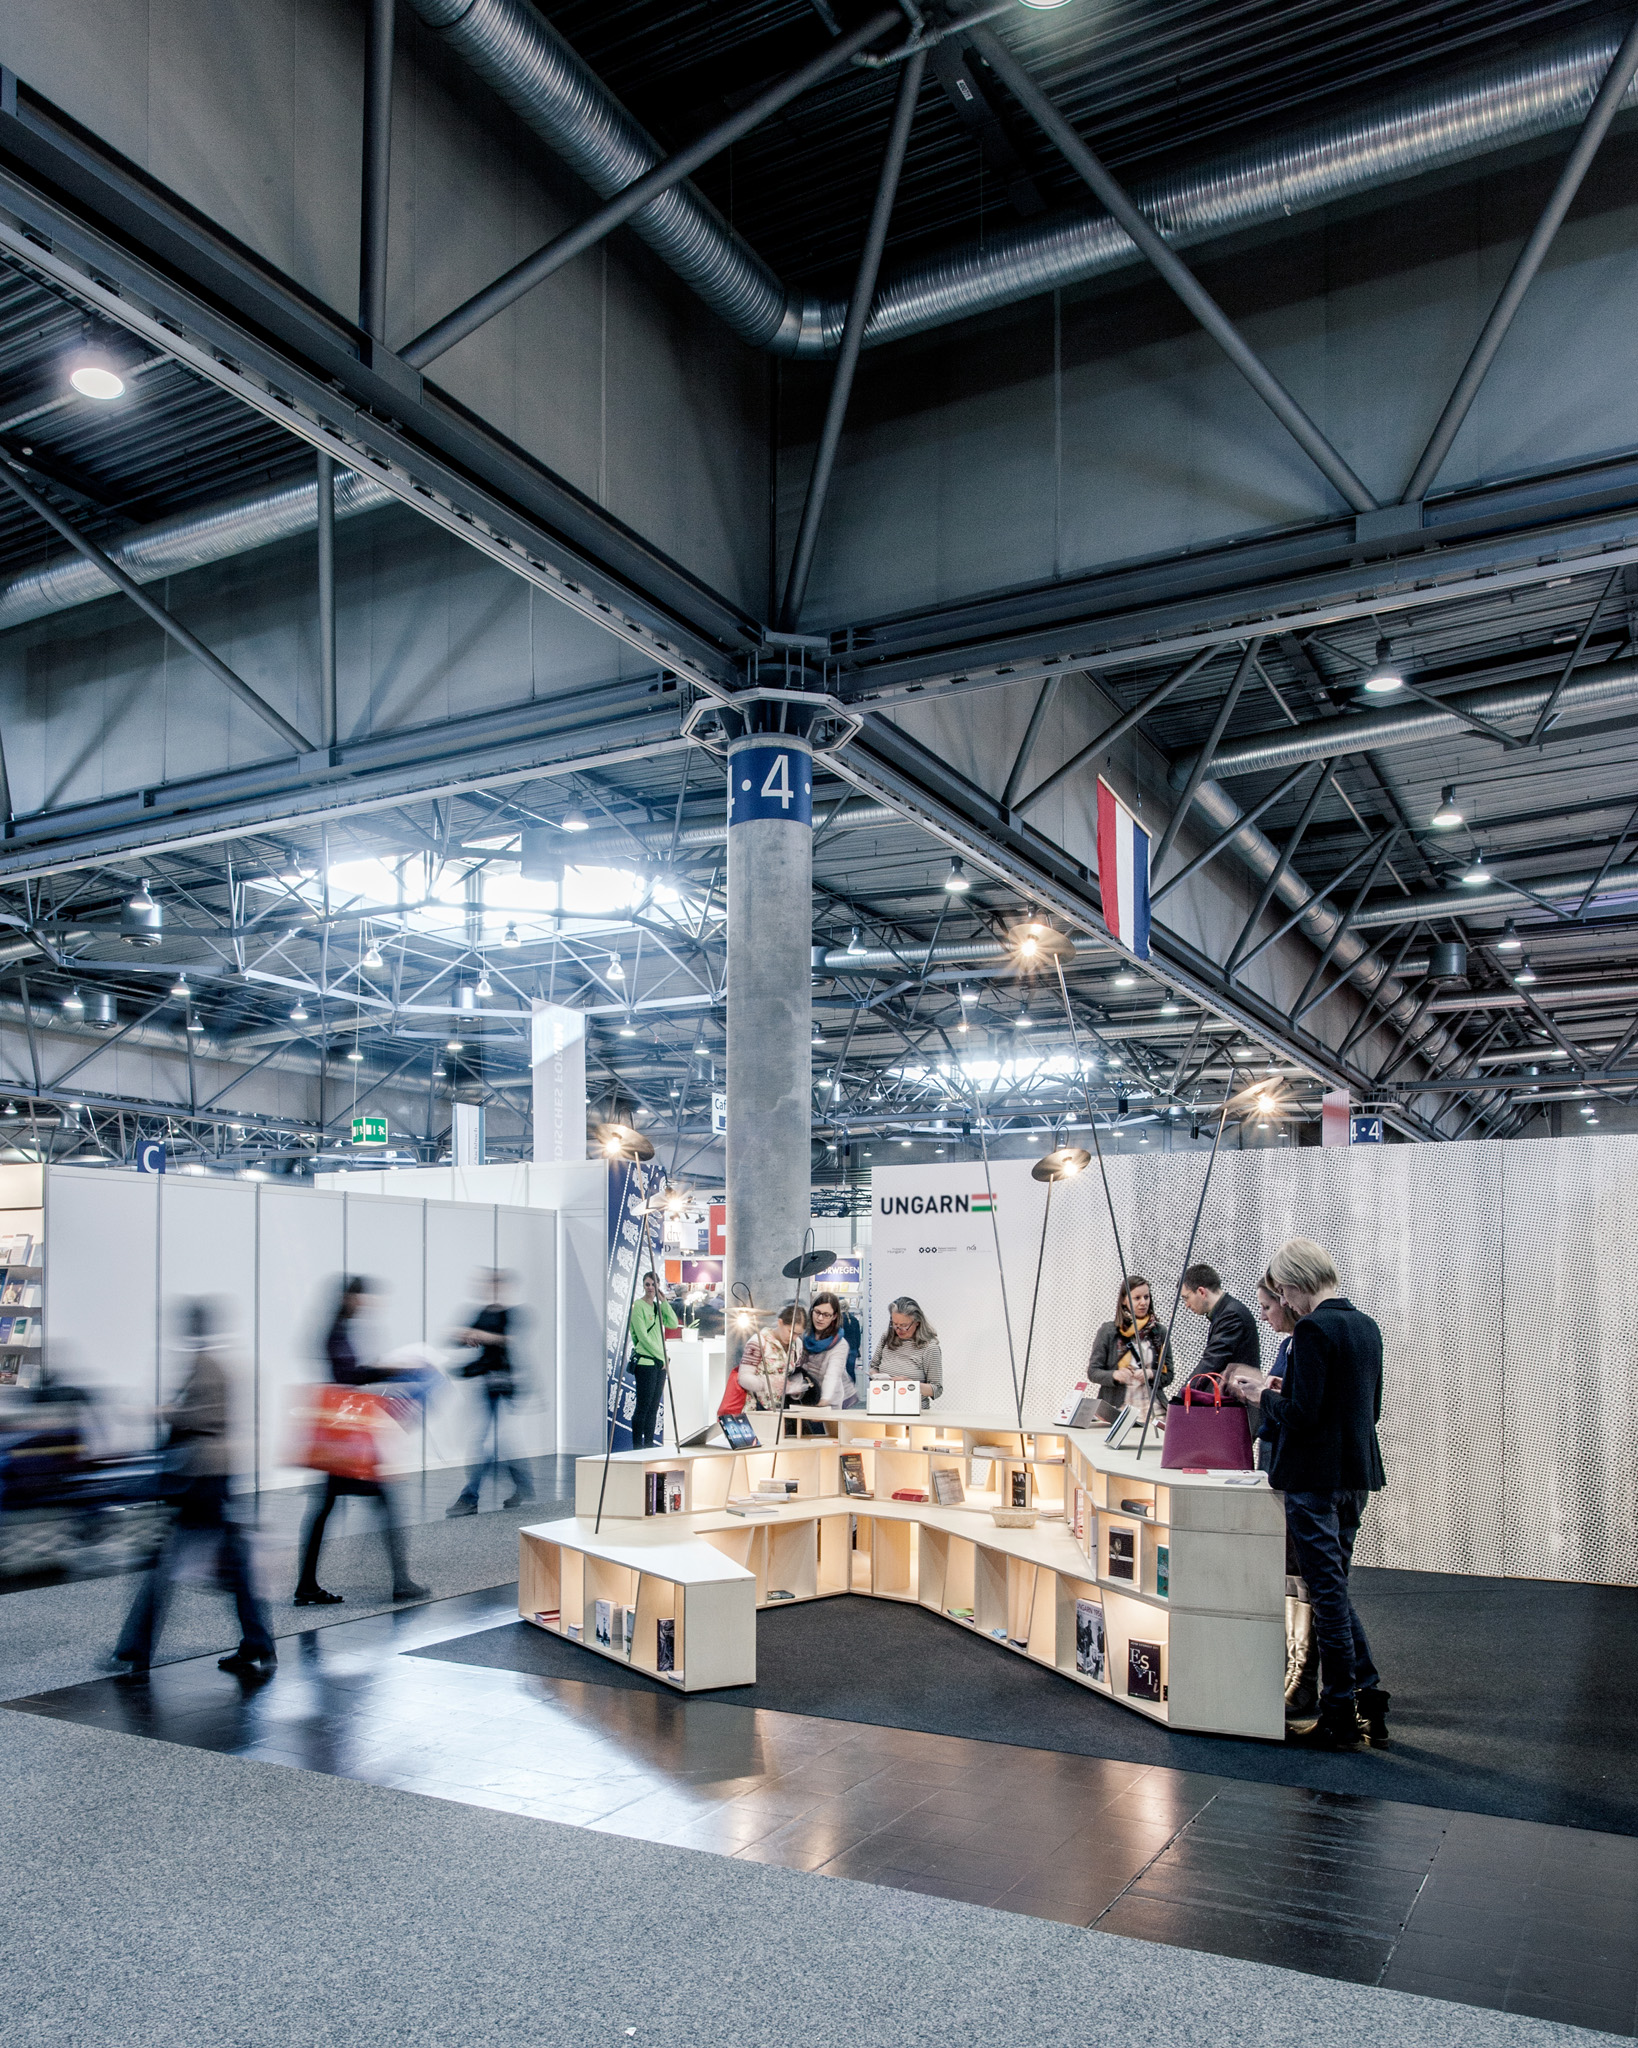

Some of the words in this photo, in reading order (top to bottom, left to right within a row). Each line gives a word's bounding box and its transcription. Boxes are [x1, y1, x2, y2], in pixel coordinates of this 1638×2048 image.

[761, 754, 794, 810] 4
[1368, 1120, 1380, 1140] 4
[143, 1145, 160, 1174] C
[880, 1194, 969, 1215] UNGARN
[664, 1244, 671, 1252] D
[816, 1266, 860, 1276] ORWEGEN
